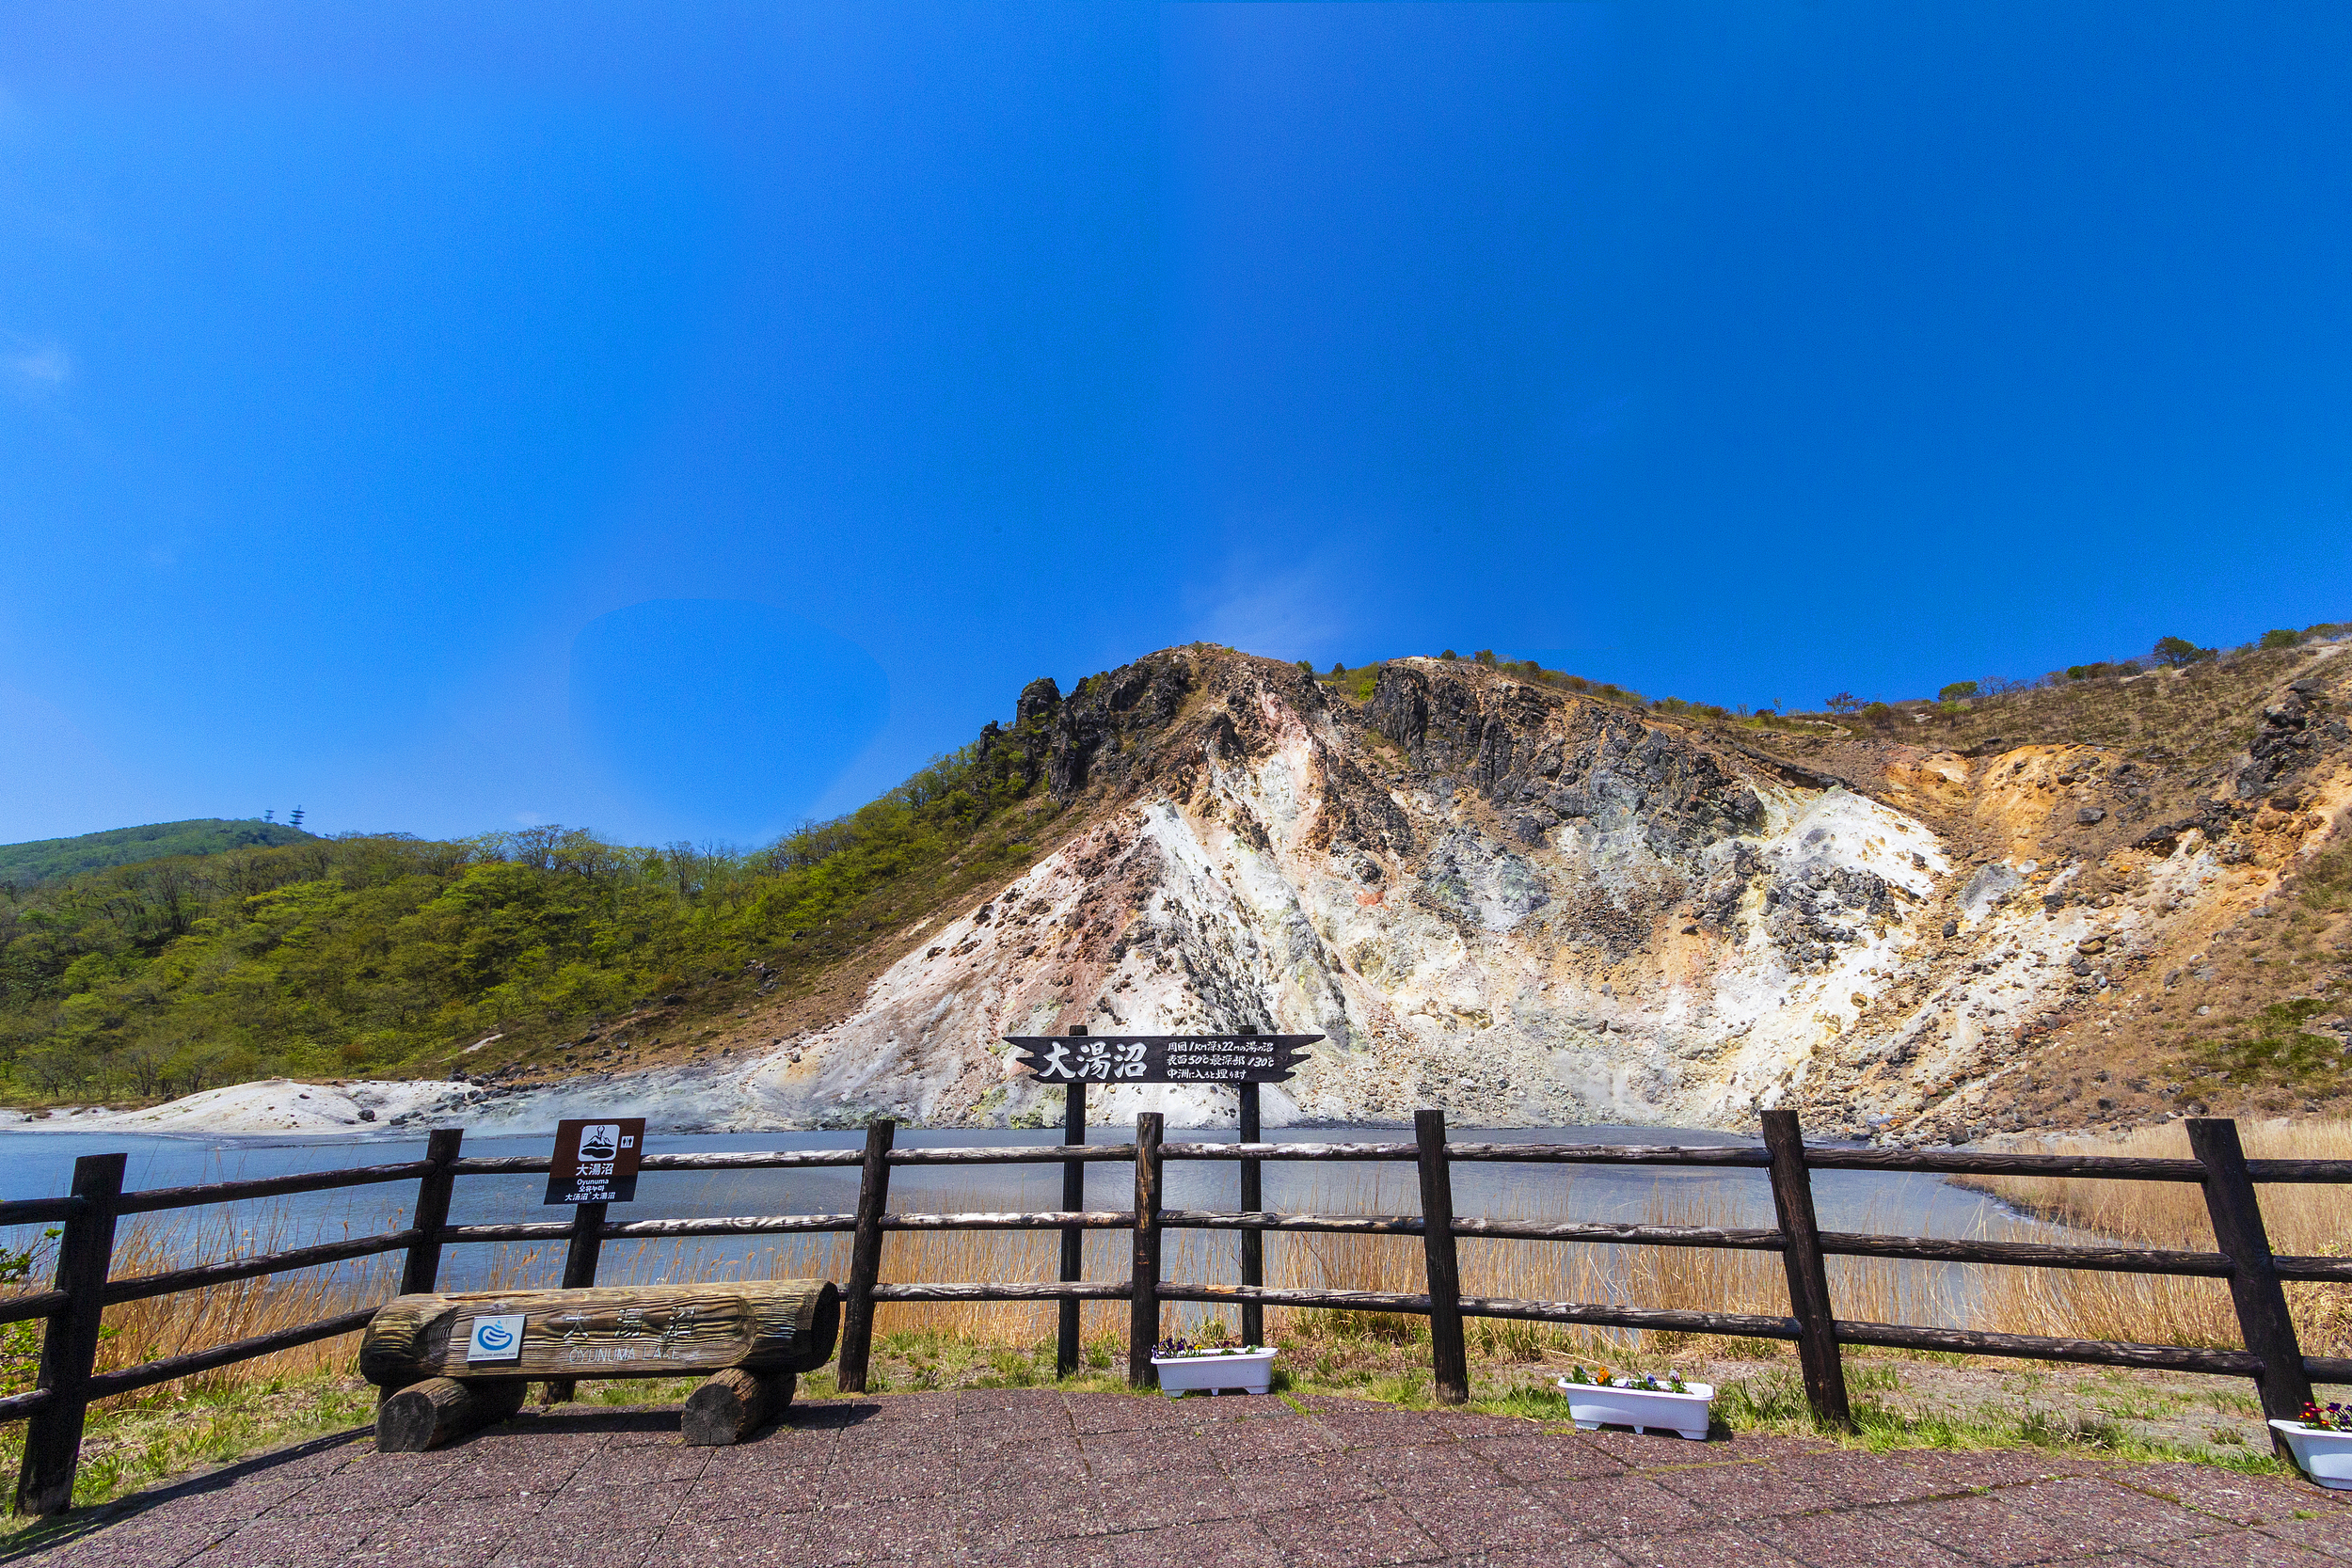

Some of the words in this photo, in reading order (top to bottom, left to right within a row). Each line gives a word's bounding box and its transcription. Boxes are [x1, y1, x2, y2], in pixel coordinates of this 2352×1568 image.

[1039, 1041, 1147, 1080] 大湯沼
[576, 1163, 614, 1175] 大湯沼
[563, 1307, 696, 1340] 大湯沼
[568, 1346, 635, 1363] OYUNUMA
[643, 1345, 679, 1361] LAKE
